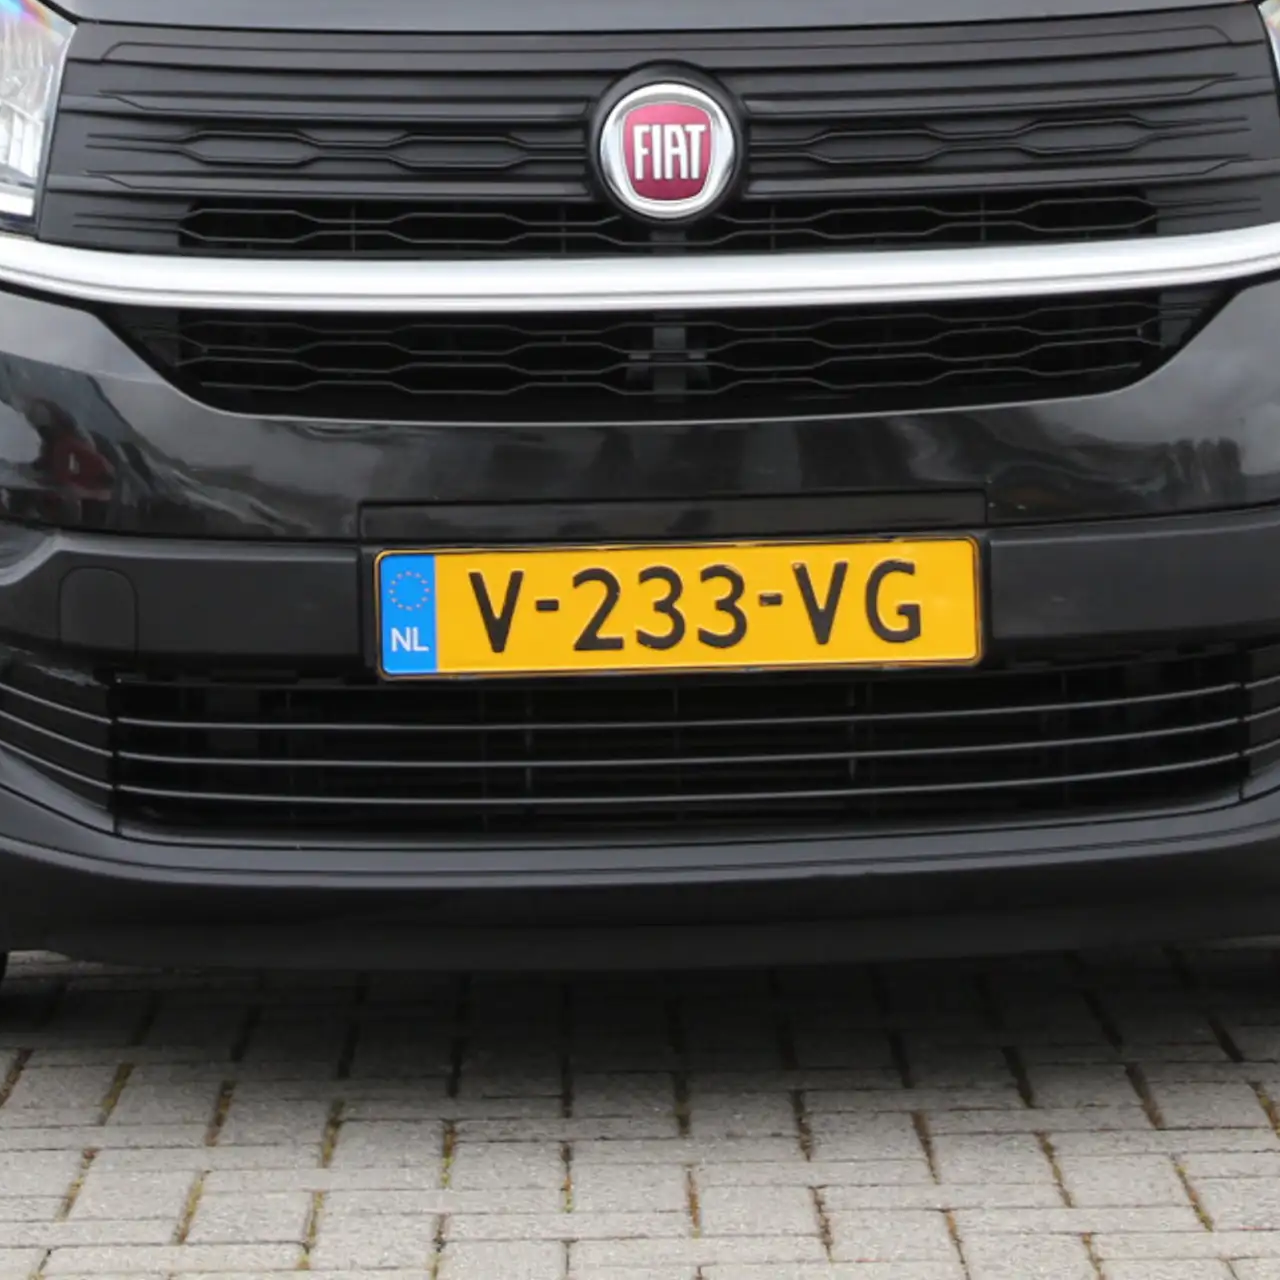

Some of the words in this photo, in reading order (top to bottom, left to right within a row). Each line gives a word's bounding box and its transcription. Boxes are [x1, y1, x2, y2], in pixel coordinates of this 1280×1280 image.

[633, 124, 707, 180] FIAT
[468, 560, 923, 654] V-233-VG
[390, 626, 430, 653] NL
